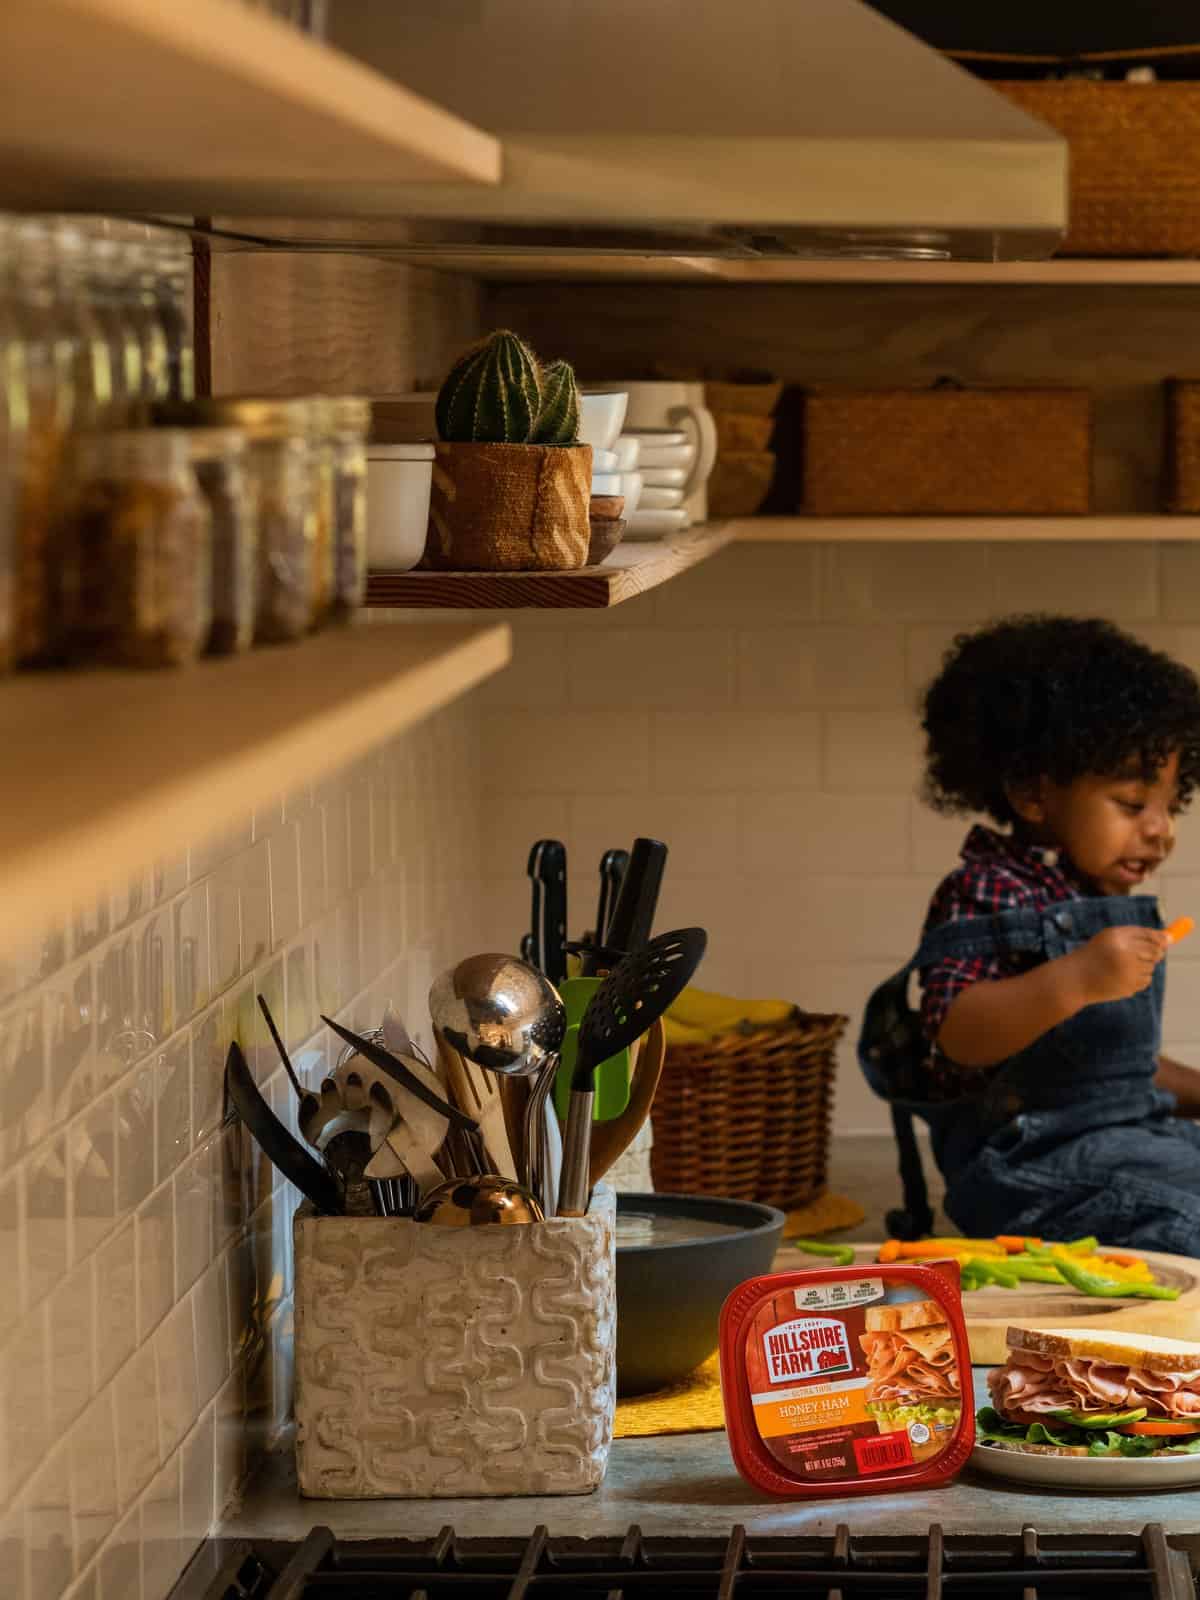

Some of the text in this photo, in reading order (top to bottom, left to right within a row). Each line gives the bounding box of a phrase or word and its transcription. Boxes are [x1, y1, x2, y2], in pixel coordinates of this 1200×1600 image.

[768, 1325, 844, 1355] HILLSHIRE
[772, 1352, 813, 1376] FARM
[779, 1402, 818, 1418] HONEY
[822, 1396, 849, 1410] HAM
